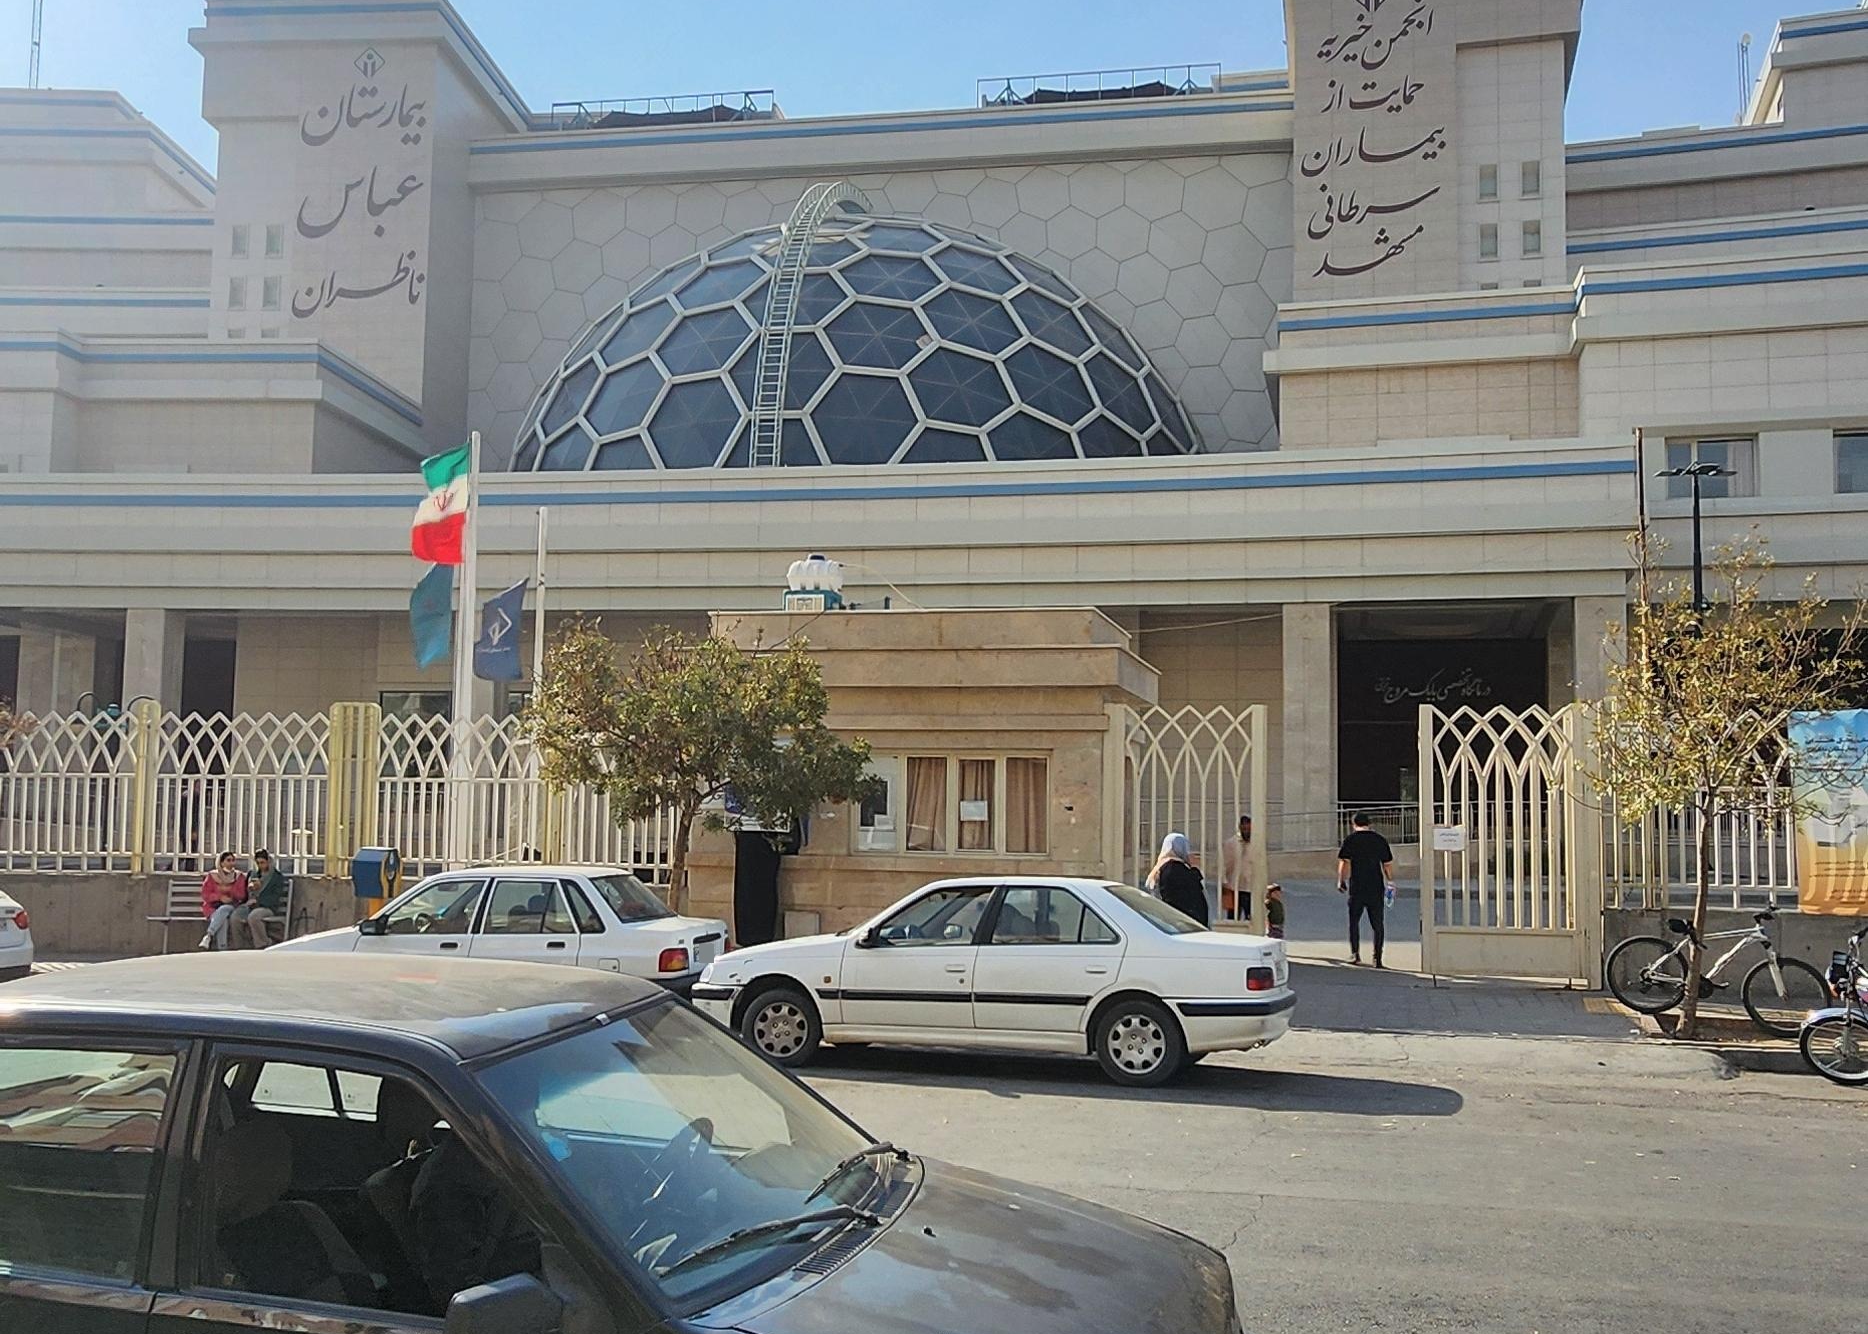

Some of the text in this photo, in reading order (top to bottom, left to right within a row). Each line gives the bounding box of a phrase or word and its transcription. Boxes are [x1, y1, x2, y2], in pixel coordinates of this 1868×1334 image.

[1316, 13, 1373, 63] خیریه
[300, 82, 427, 147] بیمارستان
[1320, 74, 1425, 113] حمایت از
[1300, 125, 1448, 178] بیماران
[296, 164, 425, 240] عباس
[1307, 183, 1441, 240] سرطانی
[1312, 223, 1424, 278] مشهد
[291, 249, 427, 319] ناظران
